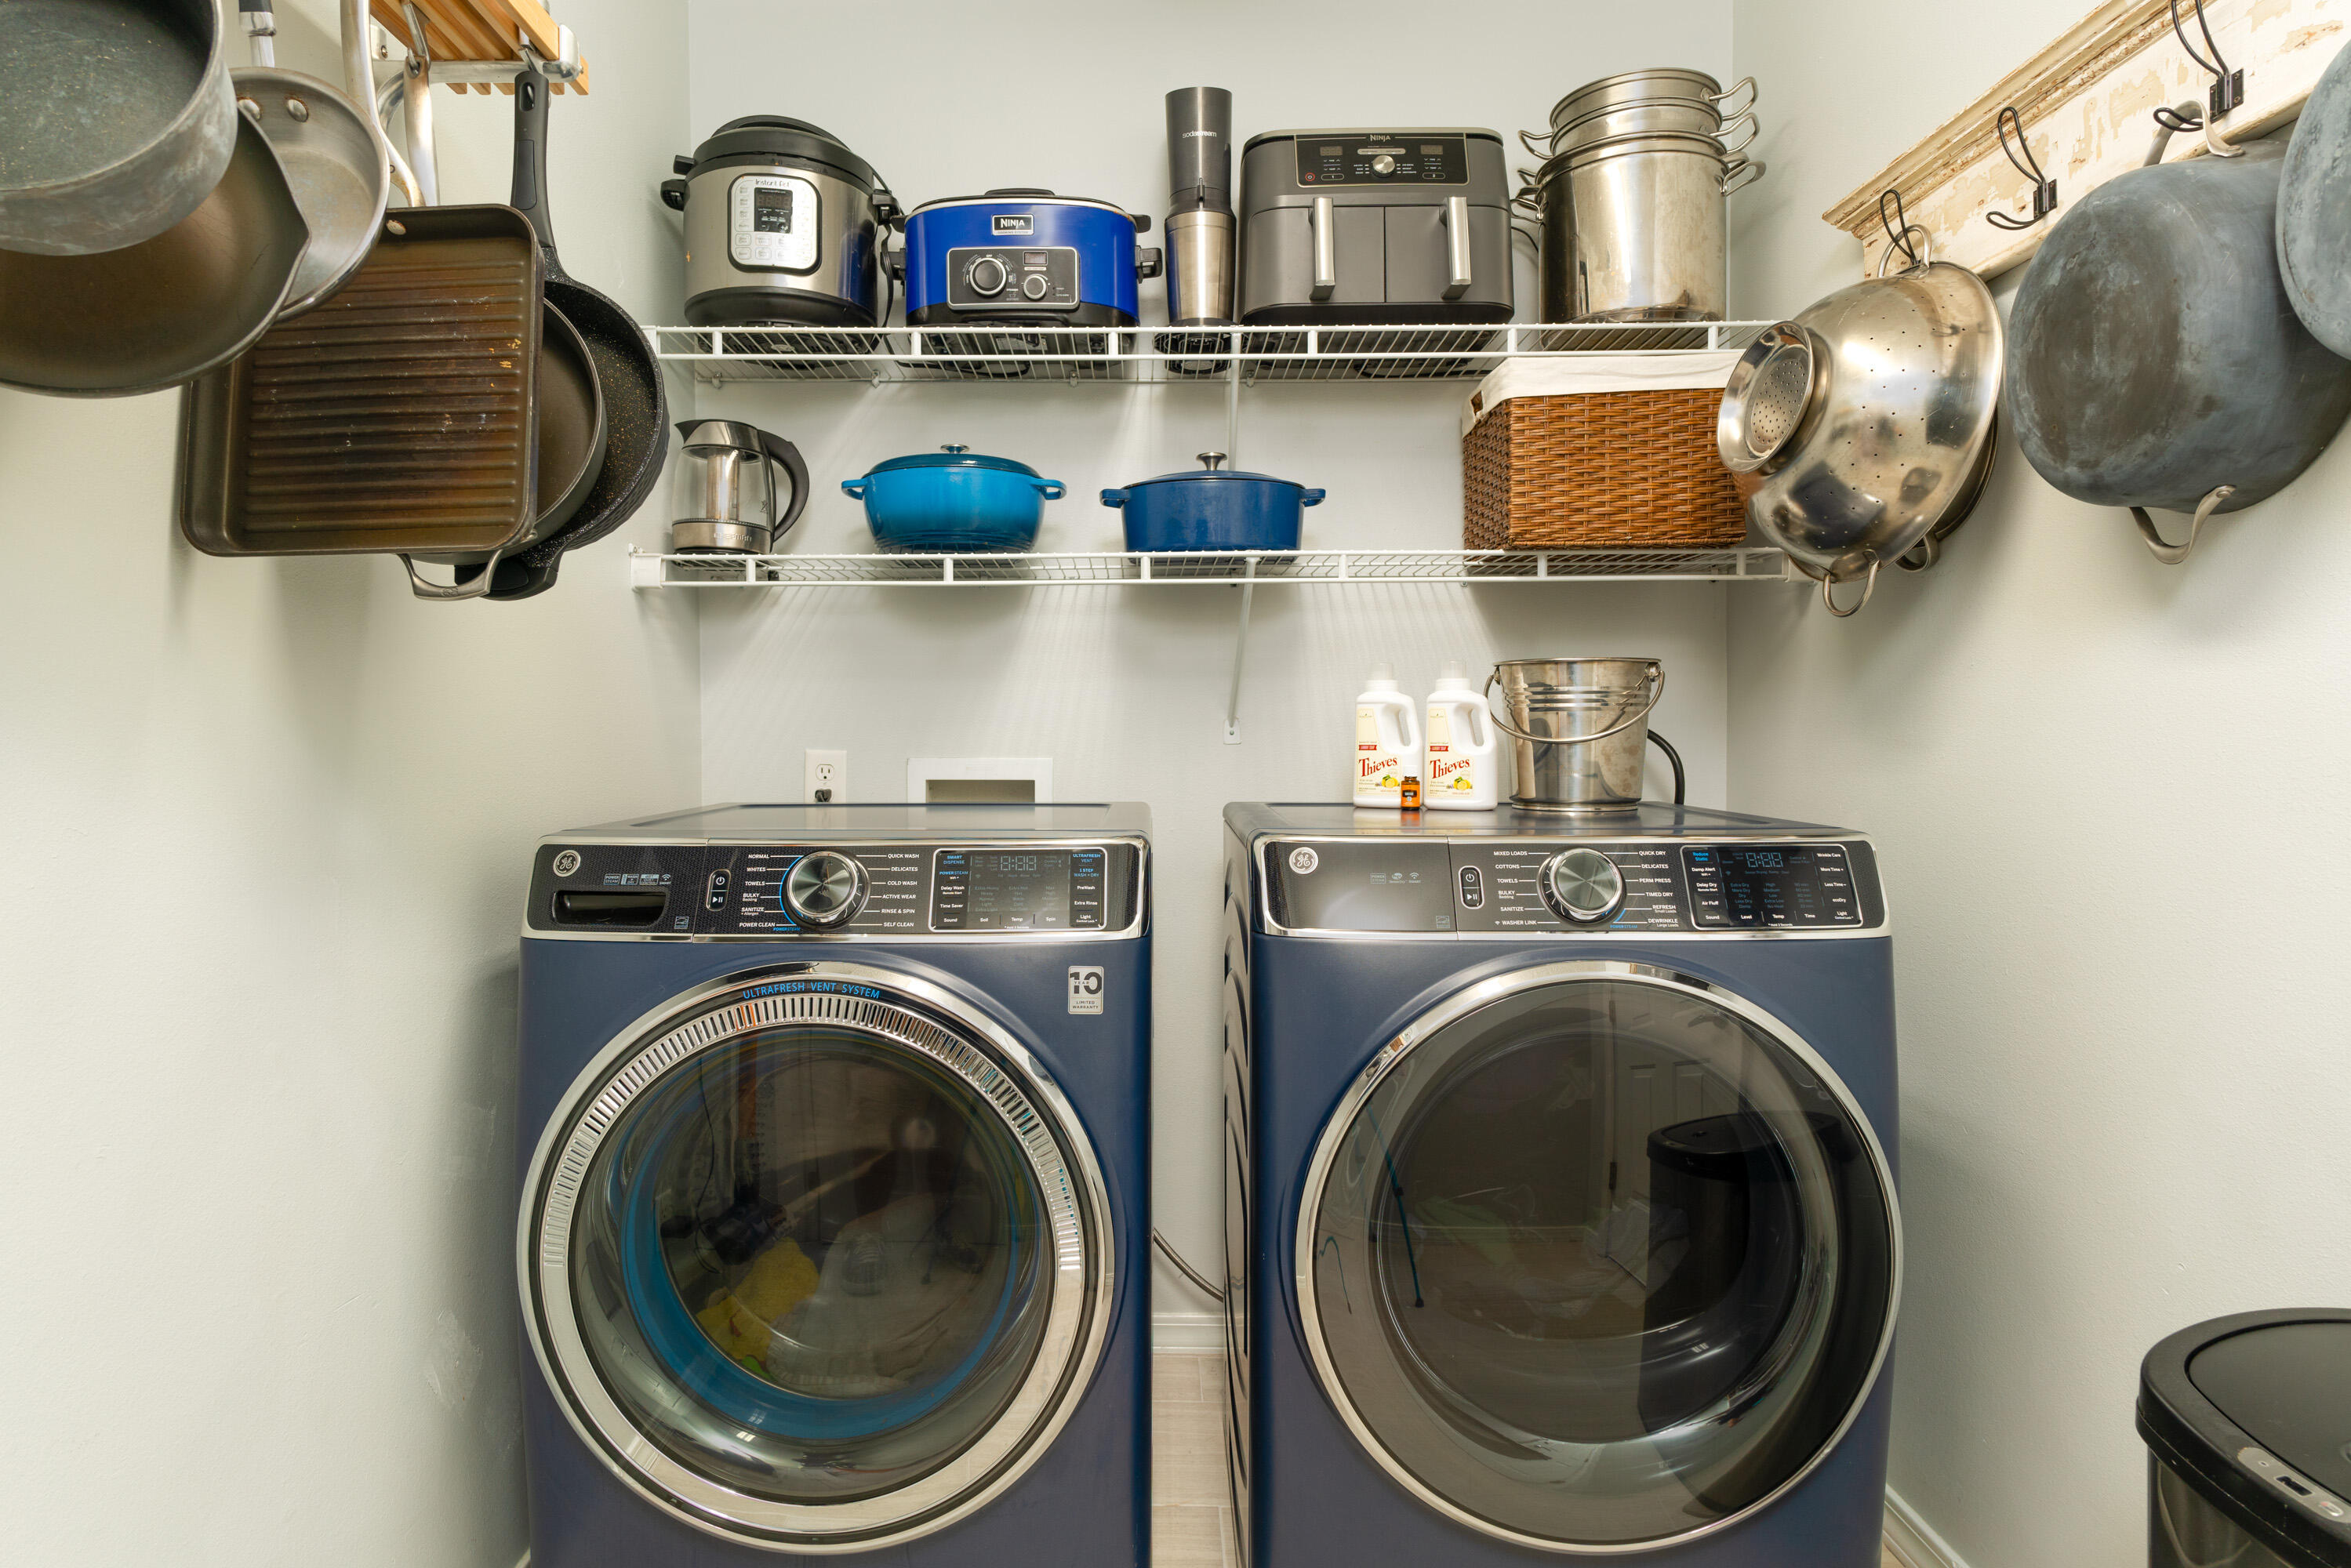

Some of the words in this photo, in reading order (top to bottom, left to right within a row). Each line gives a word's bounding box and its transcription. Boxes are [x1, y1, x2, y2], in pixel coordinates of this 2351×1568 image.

[1001, 218, 1025, 229] NINJA
[1358, 757, 1397, 777] Thieves
[1430, 758, 1470, 779] Thieves
[743, 982, 805, 999] ULTRAFRESH
[810, 982, 837, 991] VENT
[841, 984, 881, 999] SYSTEM
[1070, 972, 1102, 994] 10
